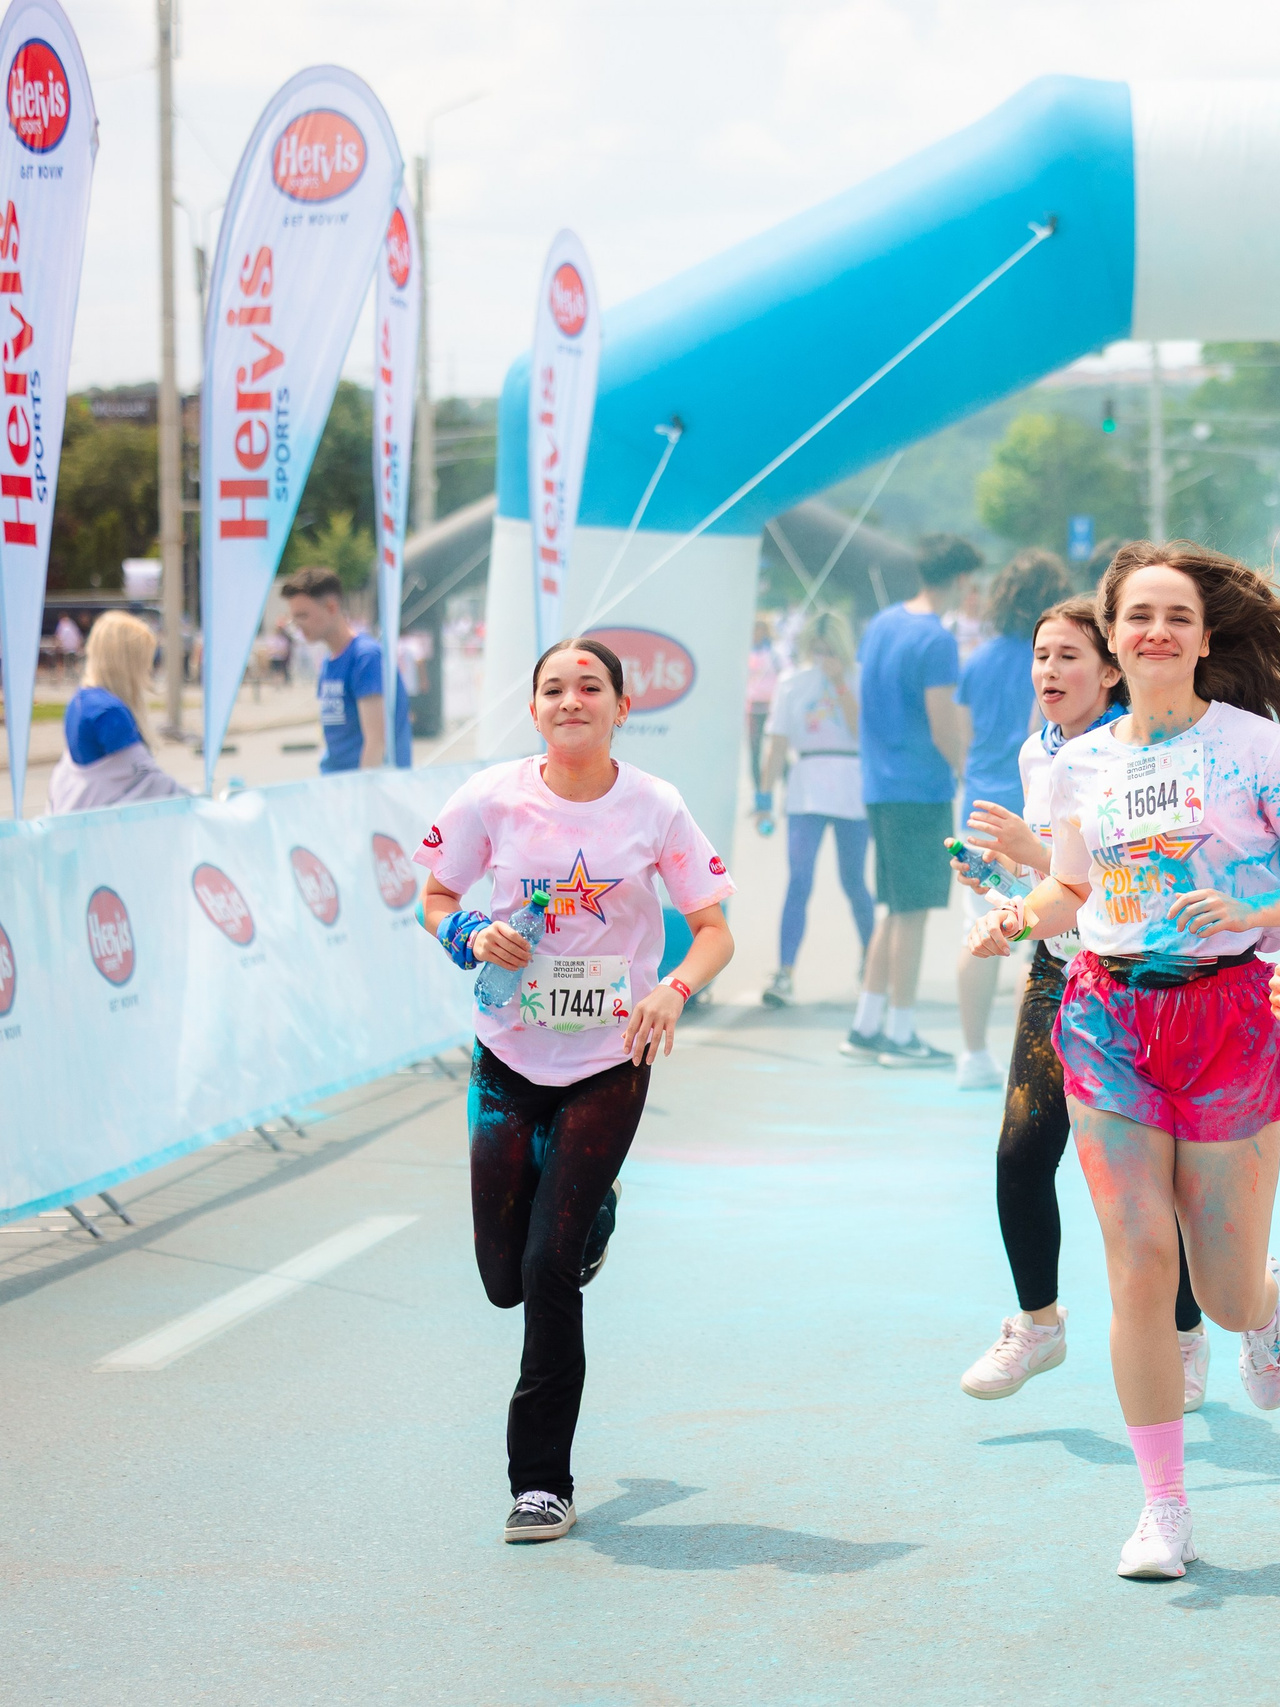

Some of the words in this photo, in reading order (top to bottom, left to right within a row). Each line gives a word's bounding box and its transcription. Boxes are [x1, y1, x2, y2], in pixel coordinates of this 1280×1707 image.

[11, 68, 66, 129] Hervis
[278, 132, 359, 184] Hervis
[219, 245, 285, 541] Hervis
[30, 369, 49, 505] SPORTS
[275, 387, 290, 504] SPORTS
[621, 650, 686, 697] rvis
[1126, 762, 1156, 774] amazing
[1131, 771, 1145, 780] tour
[1125, 779, 1179, 820] 15644
[520, 878, 552, 899] THE
[88, 911, 133, 964] Hervis
[549, 988, 606, 1017] 17447
